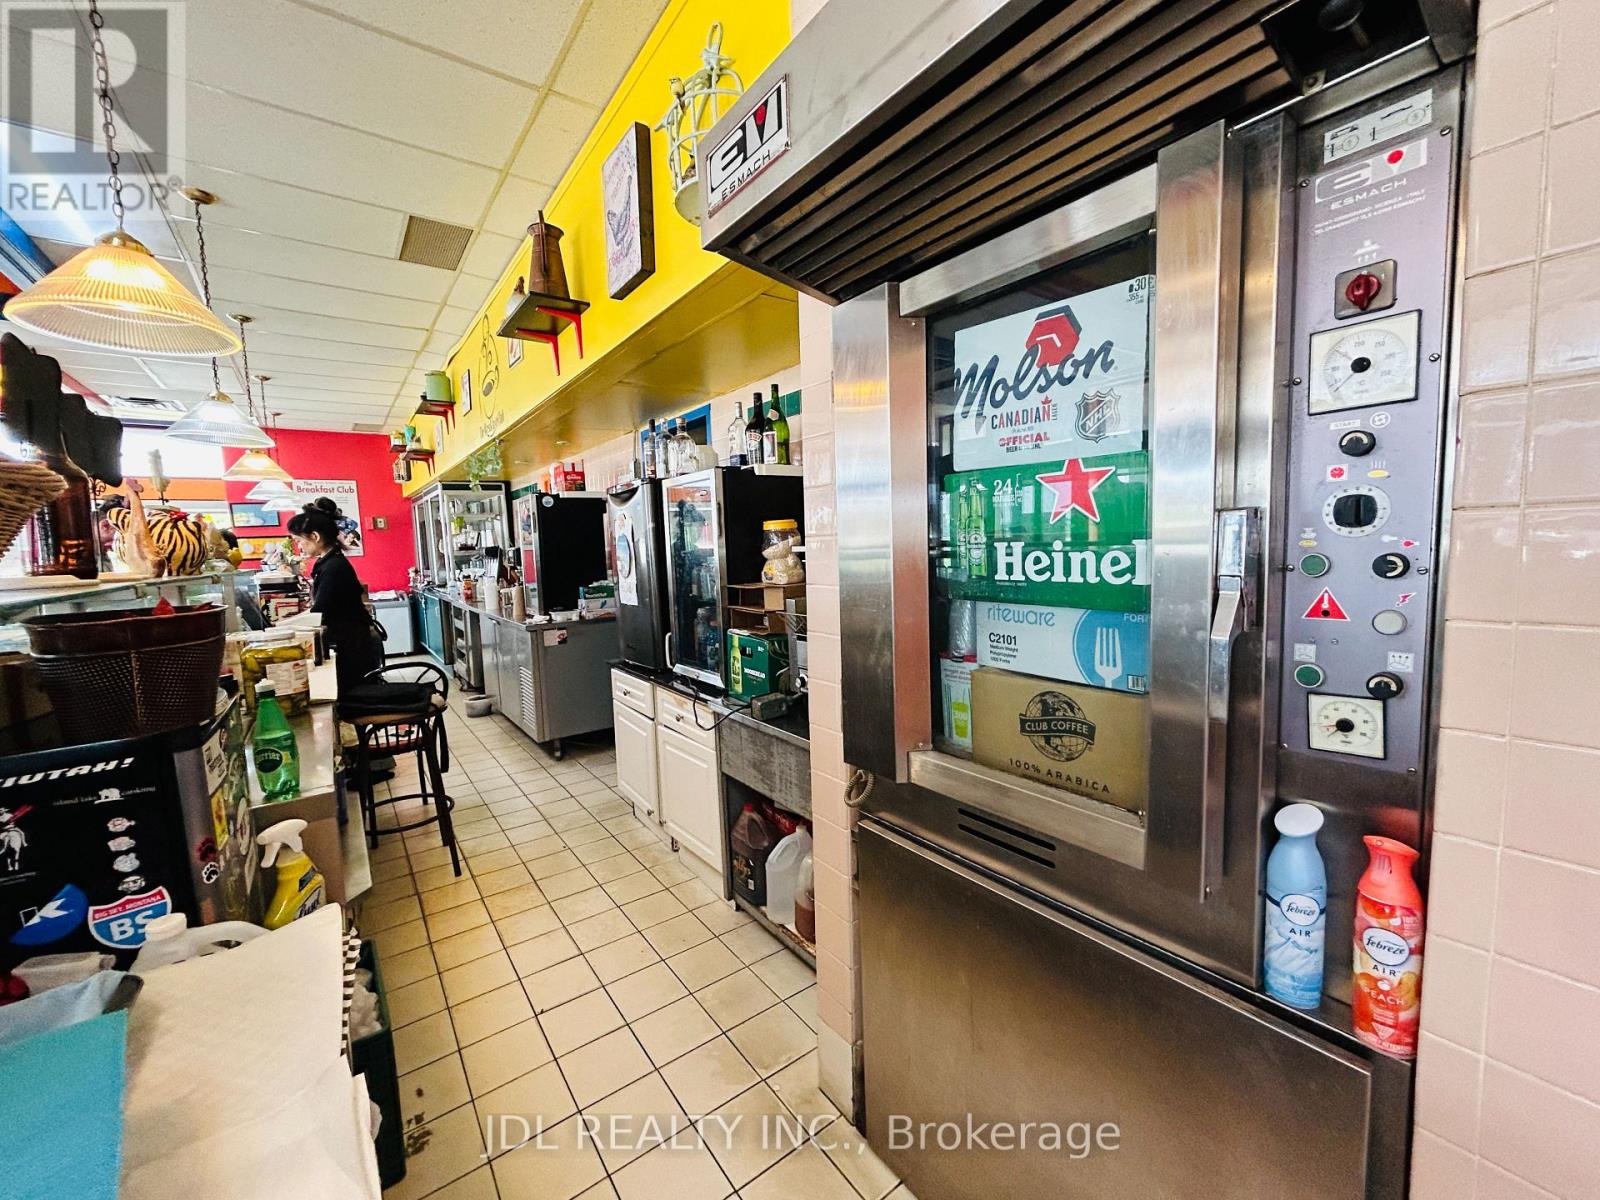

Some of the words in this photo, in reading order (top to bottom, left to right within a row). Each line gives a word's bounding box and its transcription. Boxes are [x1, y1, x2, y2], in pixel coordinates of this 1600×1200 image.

[721, 149, 772, 202] ESMACH
[1331, 177, 1407, 210] ESMACH
[1134, 276, 1147, 291] 30
[953, 339, 1115, 437] Molson
[991, 403, 1051, 430] CANADIAN
[999, 432, 1051, 448] OFFICIAL
[296, 485, 335, 494] Breakfast
[336, 486, 355, 494] Club
[993, 478, 1013, 497] 24
[987, 605, 1056, 628] riteware
[989, 632, 1018, 646] C2101
[1025, 721, 1049, 731] CLUB
[1050, 720, 1089, 734] COFFEE
[1009, 757, 1041, 774] 100%
[1046, 767, 1111, 794] ARABICA
[125, 894, 161, 909] MONTANA
[1286, 902, 1316, 916] febreze
[1289, 927, 1311, 938] AIR
[1366, 935, 1406, 955] febreze
[1372, 964, 1397, 977] AIR
[1362, 987, 1405, 1006] PEACH
